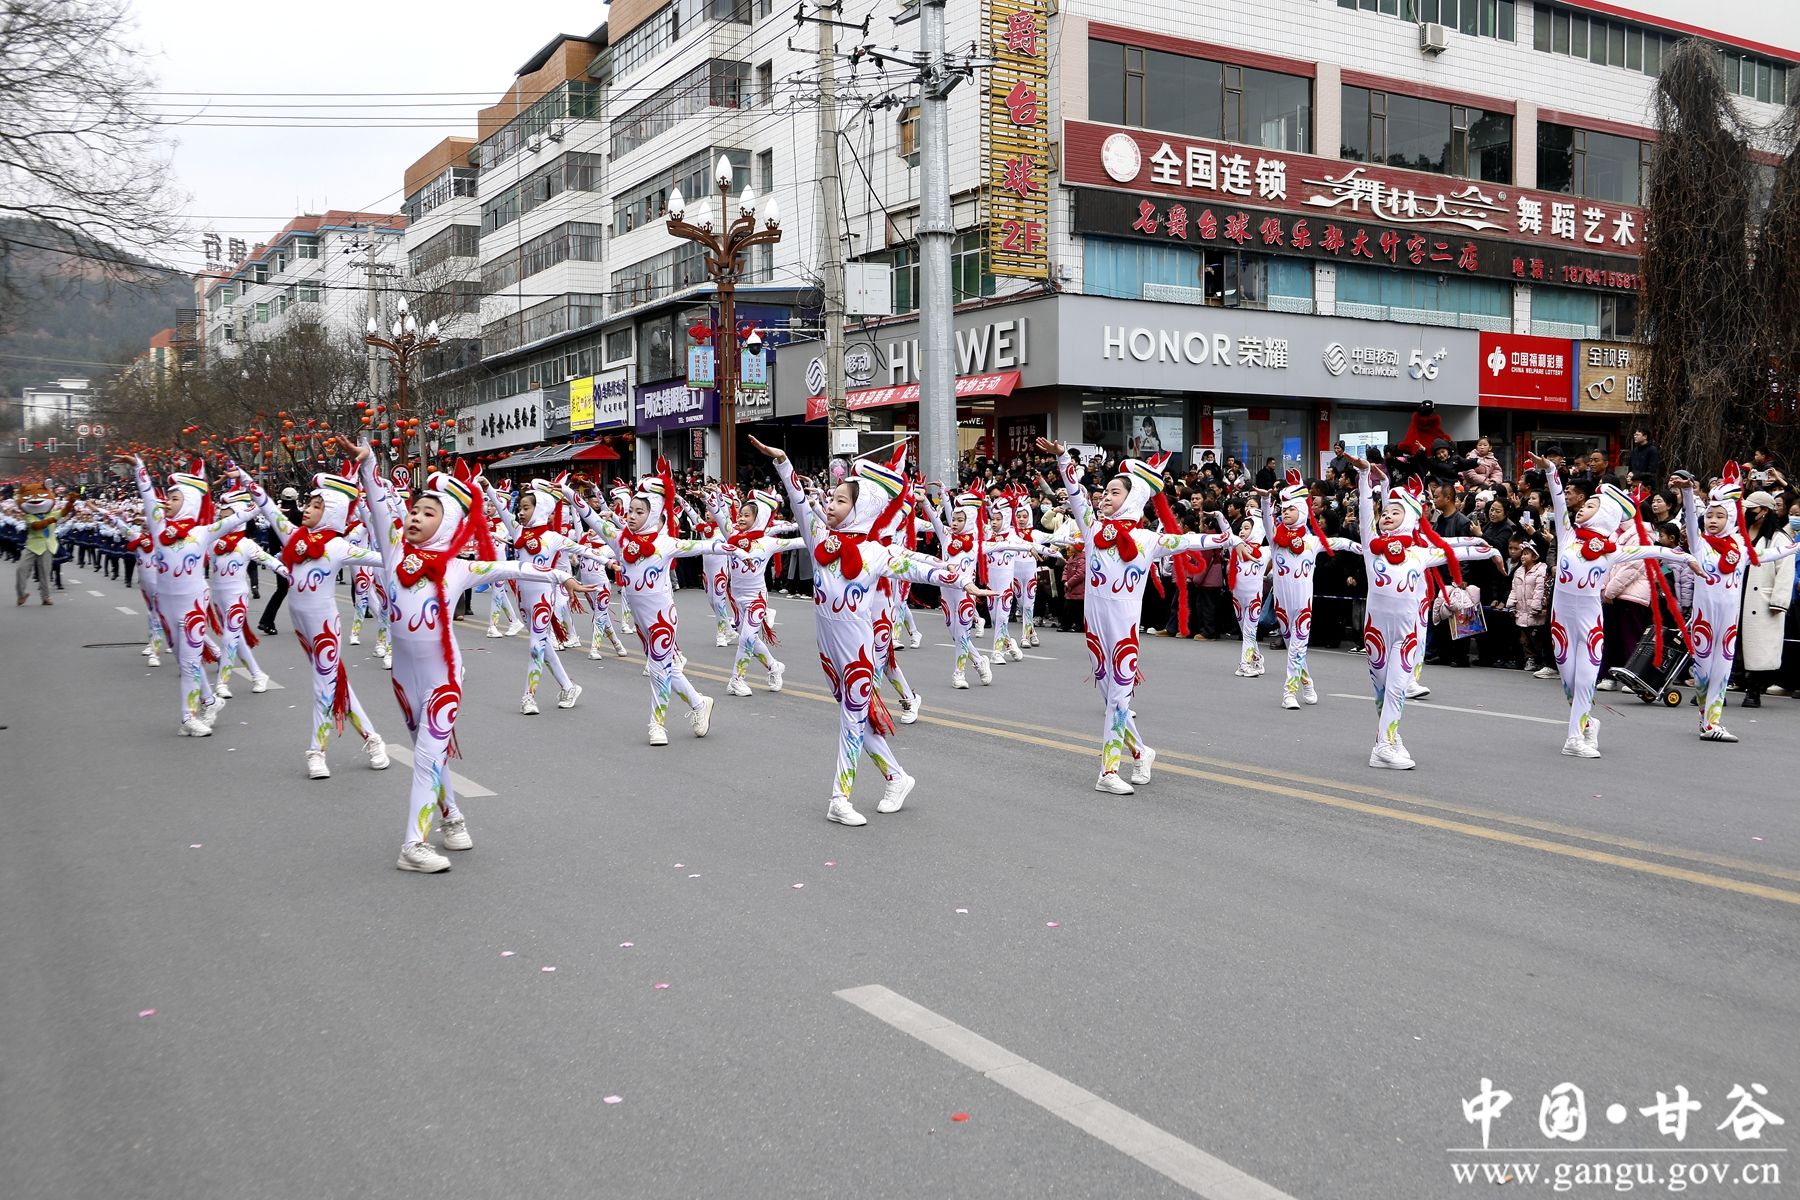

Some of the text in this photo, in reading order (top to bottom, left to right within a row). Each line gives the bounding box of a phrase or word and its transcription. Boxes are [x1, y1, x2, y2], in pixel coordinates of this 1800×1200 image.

[1150, 142, 1287, 200] 全国连锁
[1002, 219, 1042, 252] 2F
[1103, 325, 1289, 369] HONOR 荣耀
[1351, 346, 1400, 366] 中国移动
[1588, 347, 1630, 368] 全视界
[1352, 363, 1399, 378] China Mobile
[1511, 351, 1564, 370] 中国福利彩票
